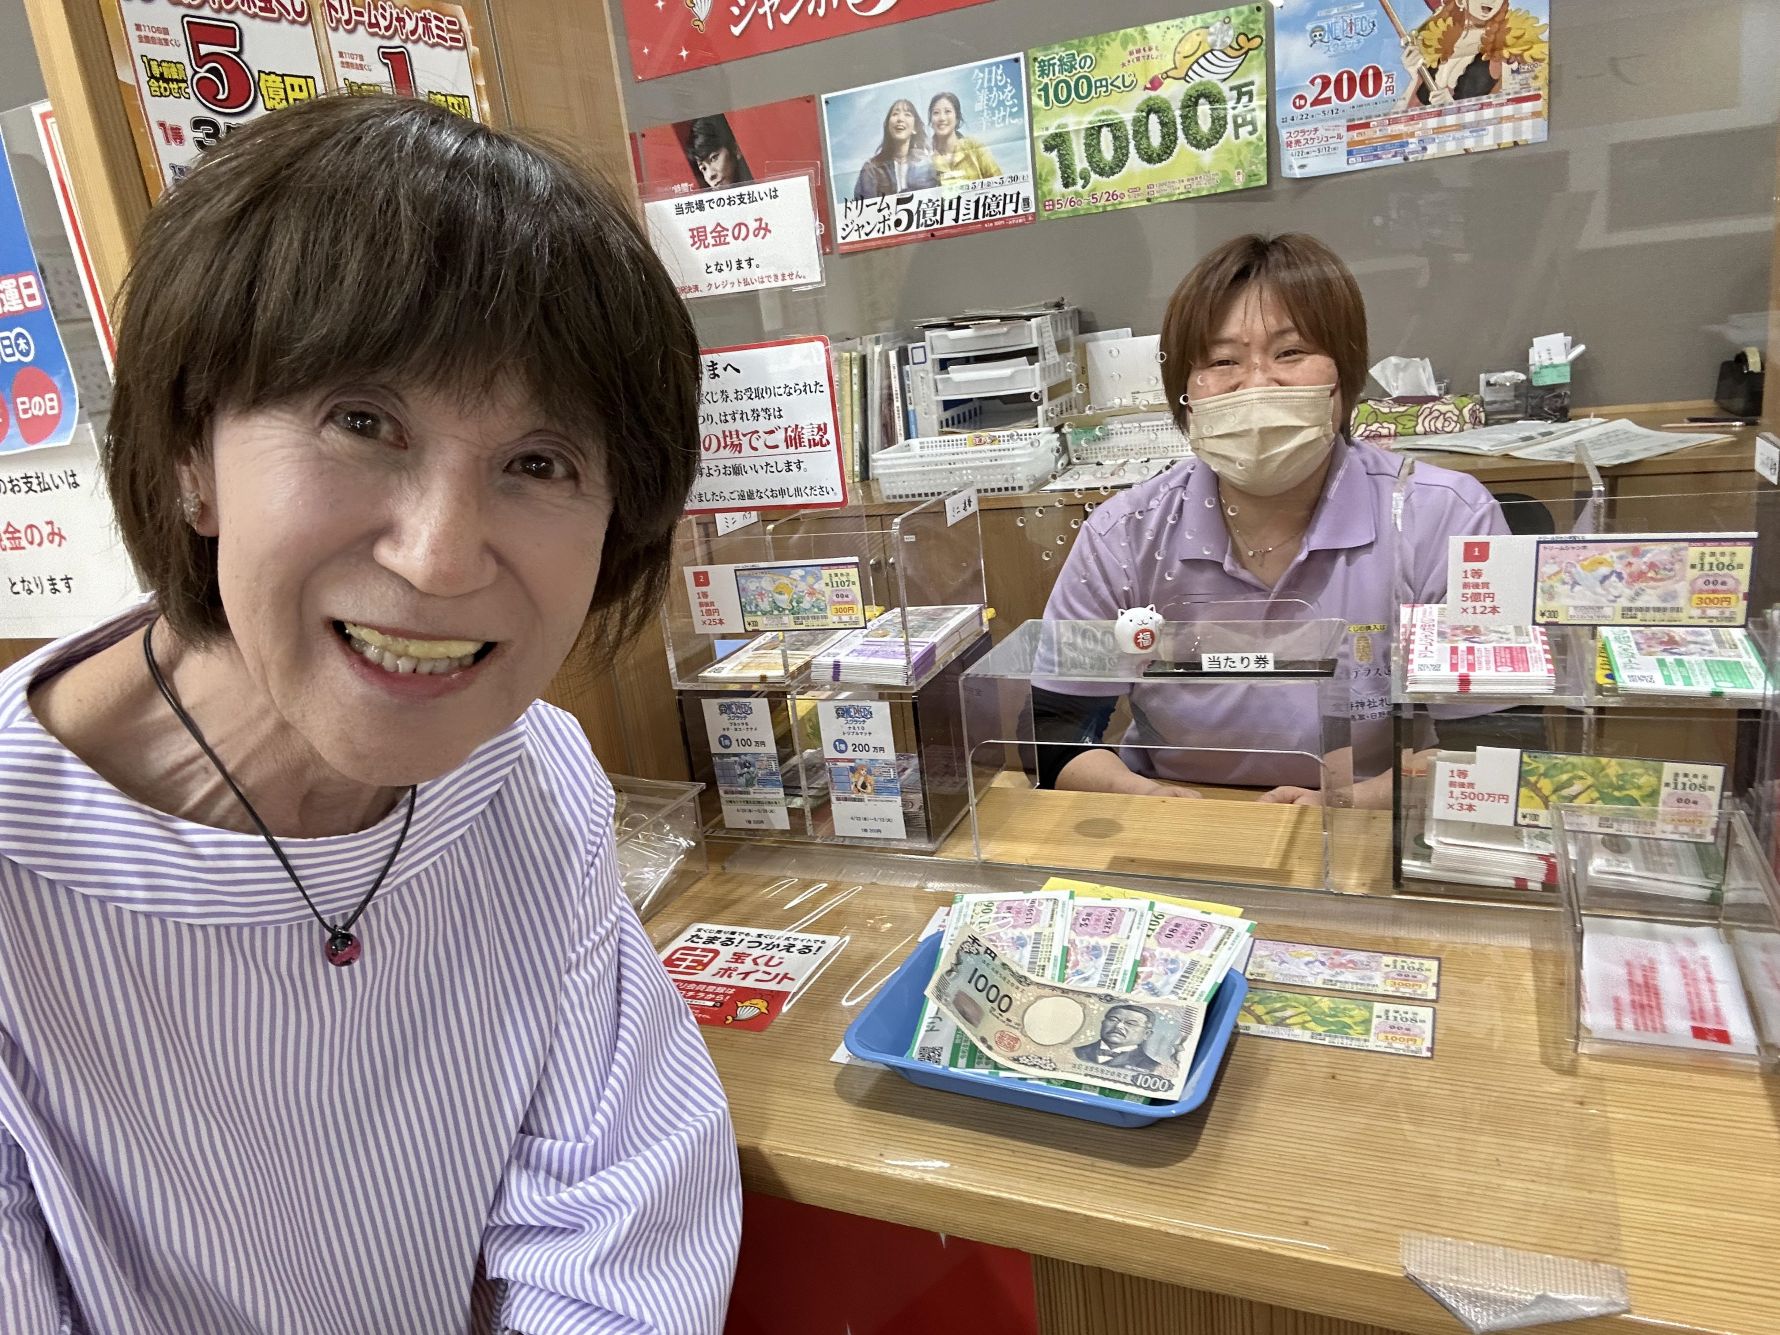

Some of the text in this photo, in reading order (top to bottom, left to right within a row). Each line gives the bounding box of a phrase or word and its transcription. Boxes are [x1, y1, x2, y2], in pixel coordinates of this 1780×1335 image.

[1036, 51, 1095, 80] 新緑の
[147, 78, 191, 99] 合わせて
[1036, 73, 1138, 109] 100円くじ
[1308, 65, 1383, 108] 200
[157, 120, 185, 147] 1等
[1042, 79, 1228, 190] 1,000
[1285, 127, 1319, 140] スクラッチ
[674, 187, 779, 216] 当売場でのお支払いは
[843, 192, 892, 220] ドリーム
[688, 216, 772, 251] 現金のみ
[841, 212, 892, 241] ジャンボ
[704, 256, 761, 275] となります。
[702, 422, 831, 455] の場でご確認
[0, 520, 67, 553] 金のみ
[1473, 548, 1480, 556] 1
[1461, 569, 1483, 579] 1等
[9, 575, 73, 595] となります
[1461, 582, 1490, 590] 前後賞
[1460, 592, 1496, 603] 5億円
[1695, 596, 1732, 606] 300円
[833, 606, 855, 614] 300円
[1460, 605, 1500, 616] ×12本
[701, 618, 725, 626] ×25本
[1137, 632, 1152, 646] 福
[1206, 654, 1271, 671] 当たり券
[1448, 769, 1469, 780] 1等
[1447, 790, 1510, 804] 1,500万円
[1447, 803, 1477, 813] ×3本
[684, 933, 823, 956] たまる!つかえる!
[725, 951, 785, 968] 宝くじ
[711, 966, 797, 985] ポイント
[967, 967, 1013, 1014] 1000
[1137, 1074, 1169, 1091] 1000
